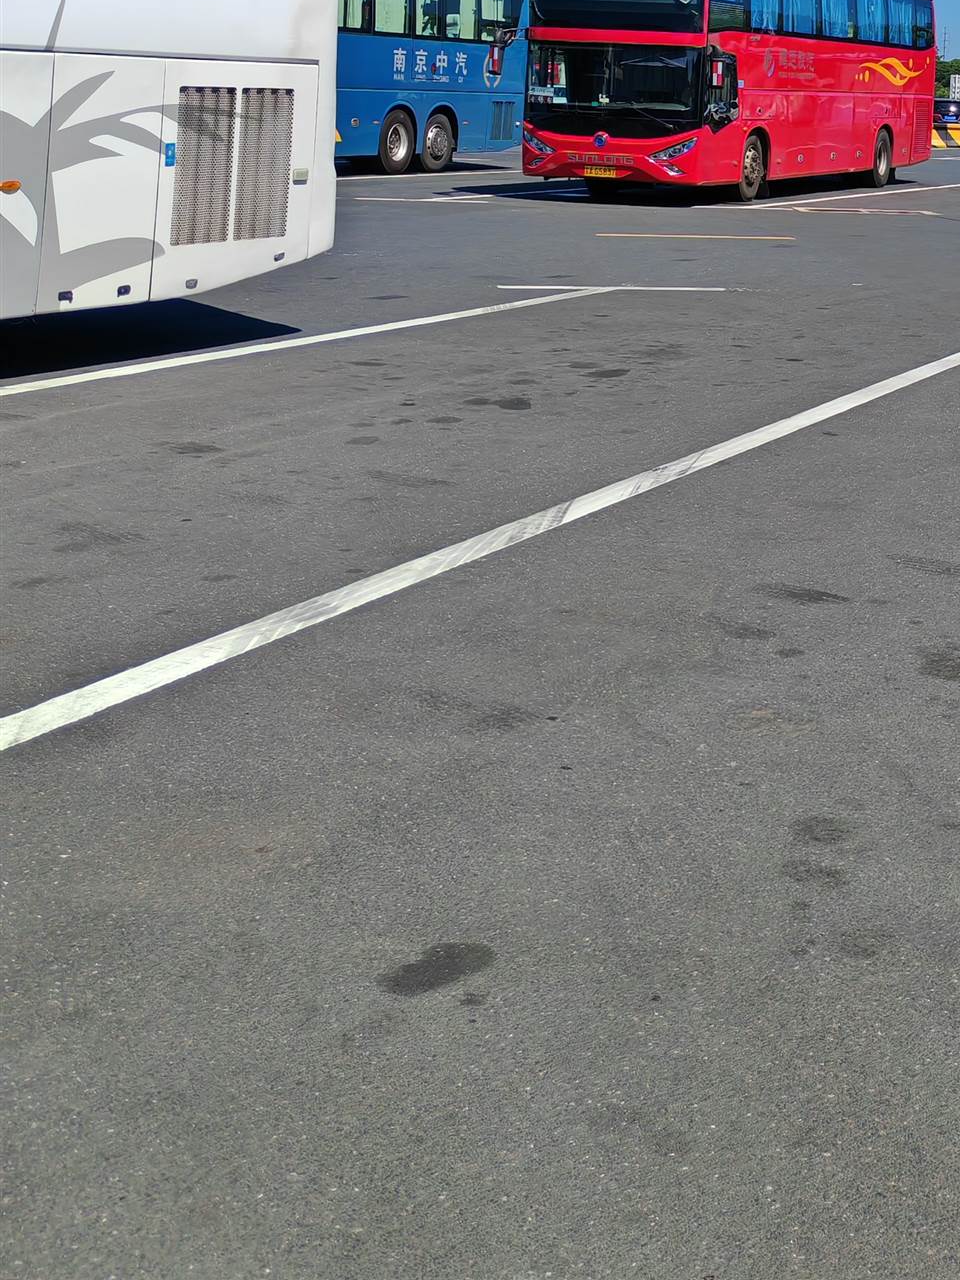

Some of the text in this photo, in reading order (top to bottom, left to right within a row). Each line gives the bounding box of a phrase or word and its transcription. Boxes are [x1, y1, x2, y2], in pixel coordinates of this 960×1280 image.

[393, 48, 468, 76] 南京中汽
[567, 153, 634, 165] SUNLONG
